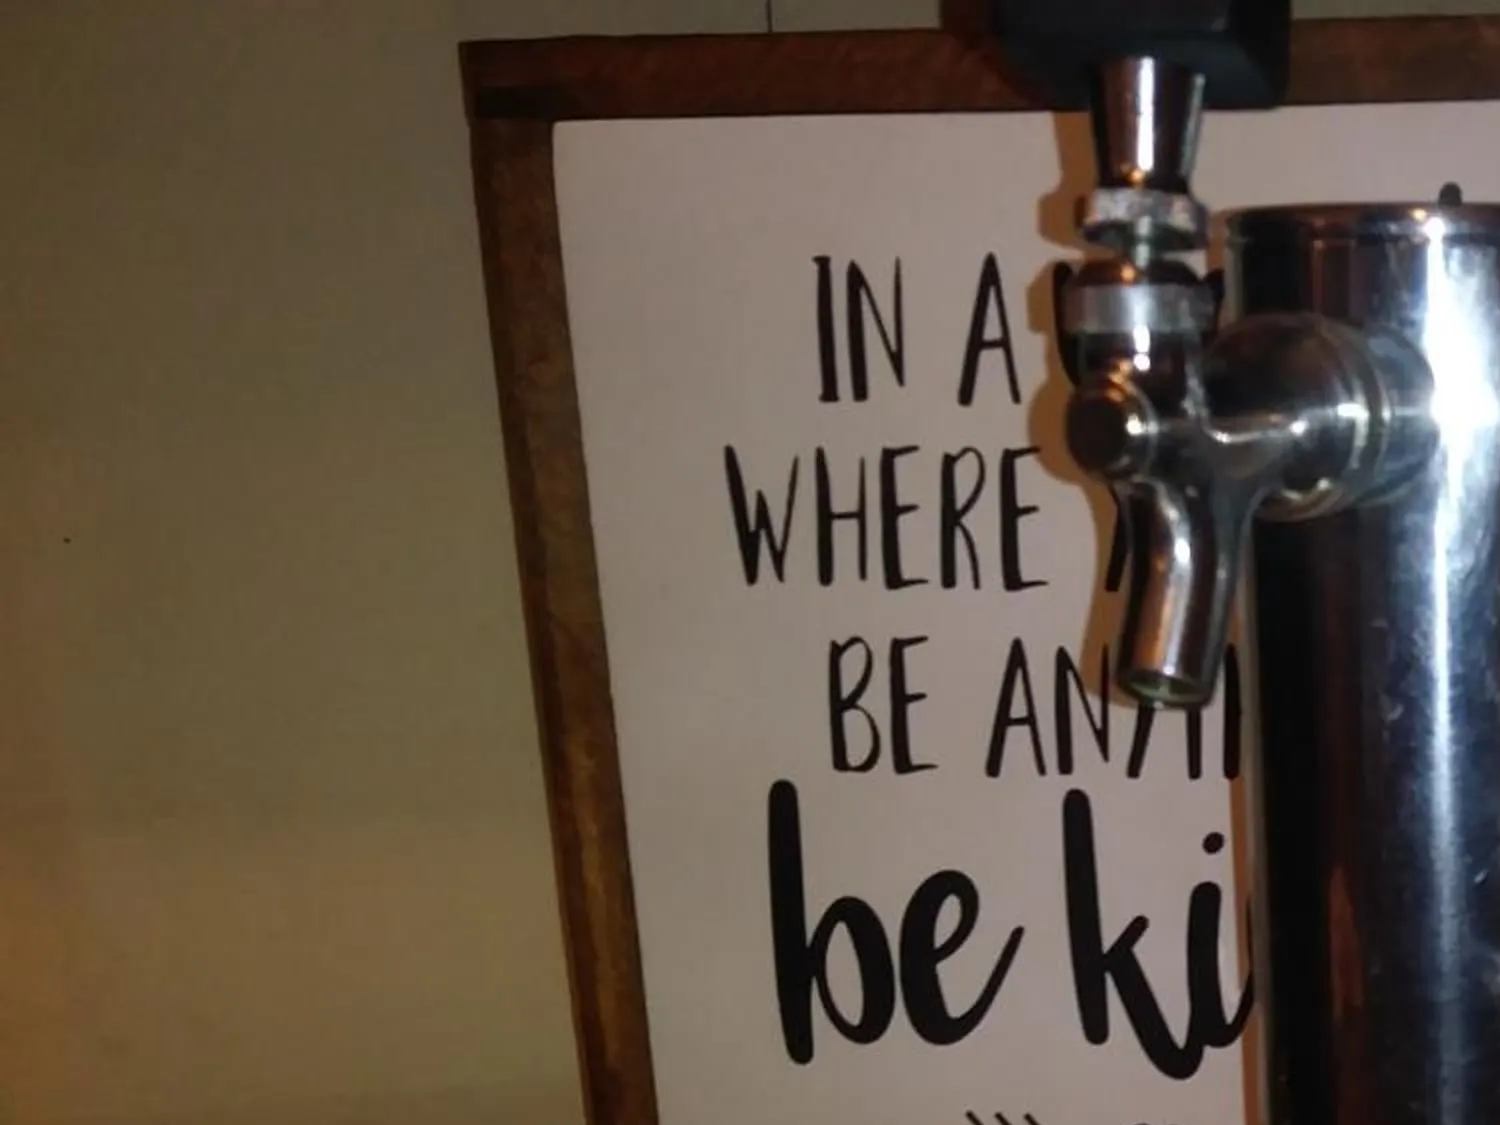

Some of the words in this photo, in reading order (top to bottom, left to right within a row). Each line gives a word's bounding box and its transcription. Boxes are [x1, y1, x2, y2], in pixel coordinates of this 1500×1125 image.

[812, 254, 906, 404] IN
[957, 252, 1021, 406] A
[723, 444, 1048, 591] WHERE
[828, 635, 938, 775] BE
[768, 779, 1024, 1065] be
[1063, 788, 1254, 1080] ki
